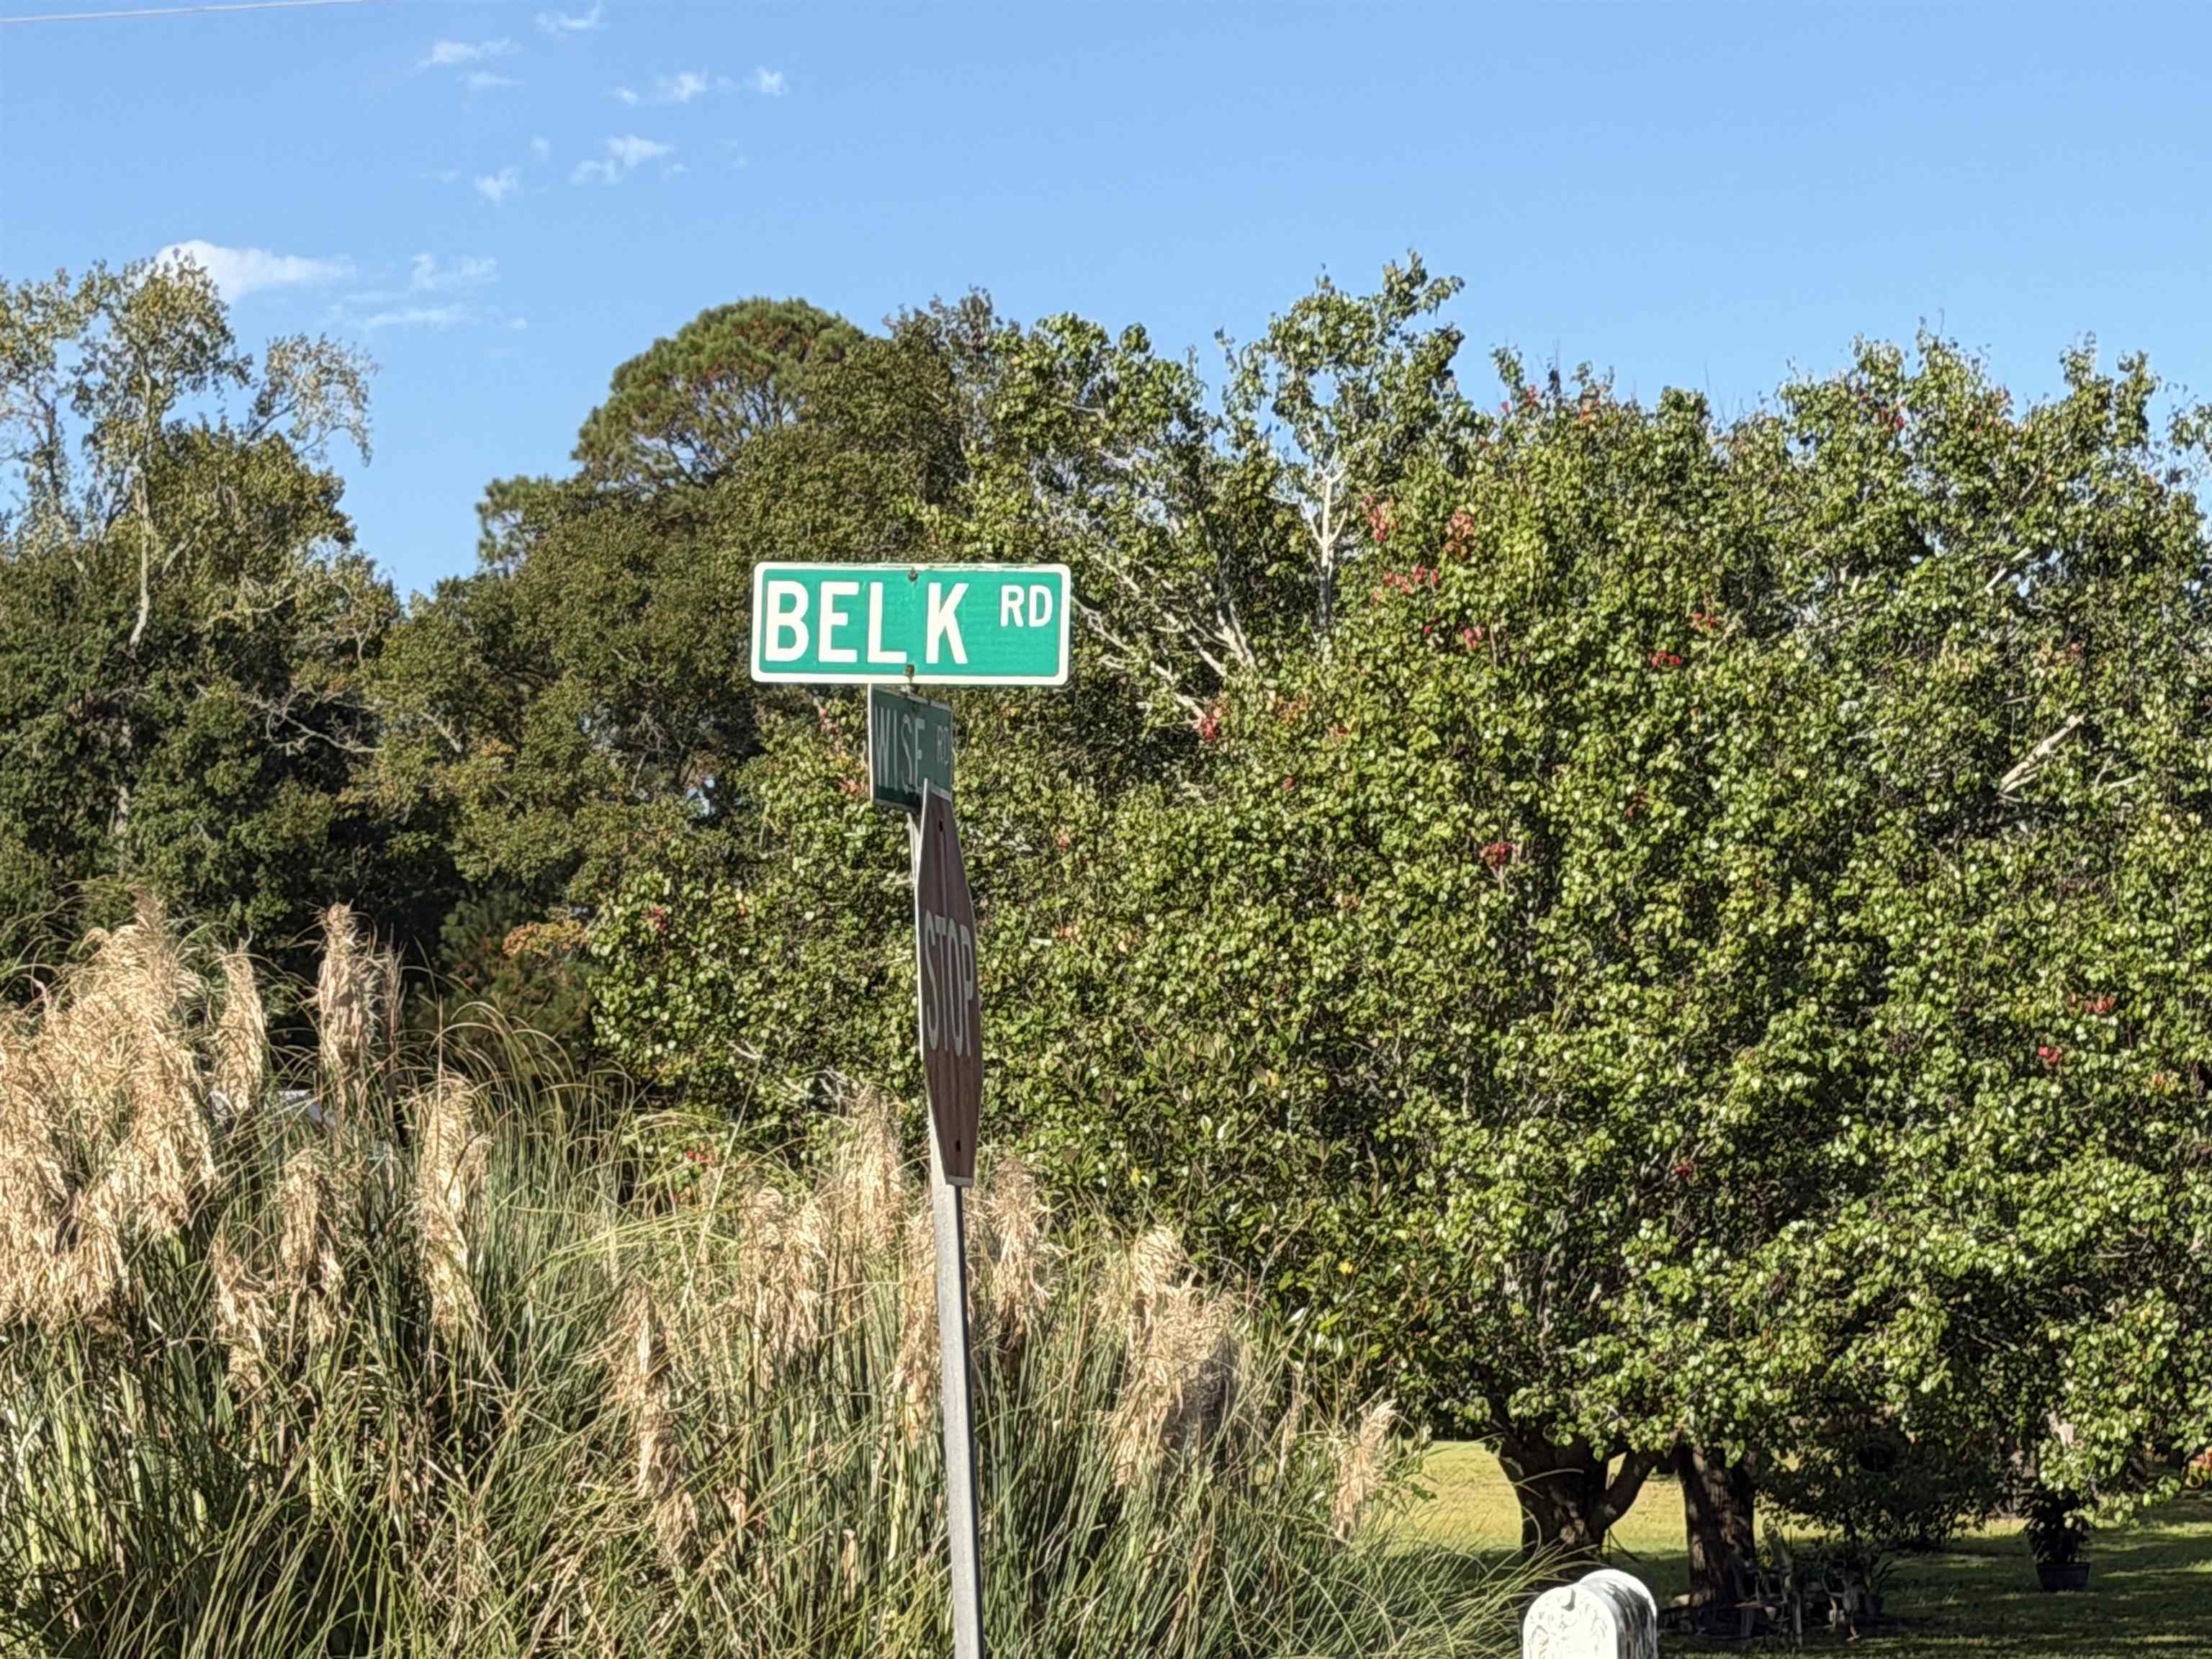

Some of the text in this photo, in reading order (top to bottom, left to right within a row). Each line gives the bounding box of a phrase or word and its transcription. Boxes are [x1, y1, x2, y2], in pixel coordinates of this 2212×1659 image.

[765, 580, 1053, 665] BELK RD
[874, 705, 925, 796] WISE
[924, 907, 974, 1058] STOP
